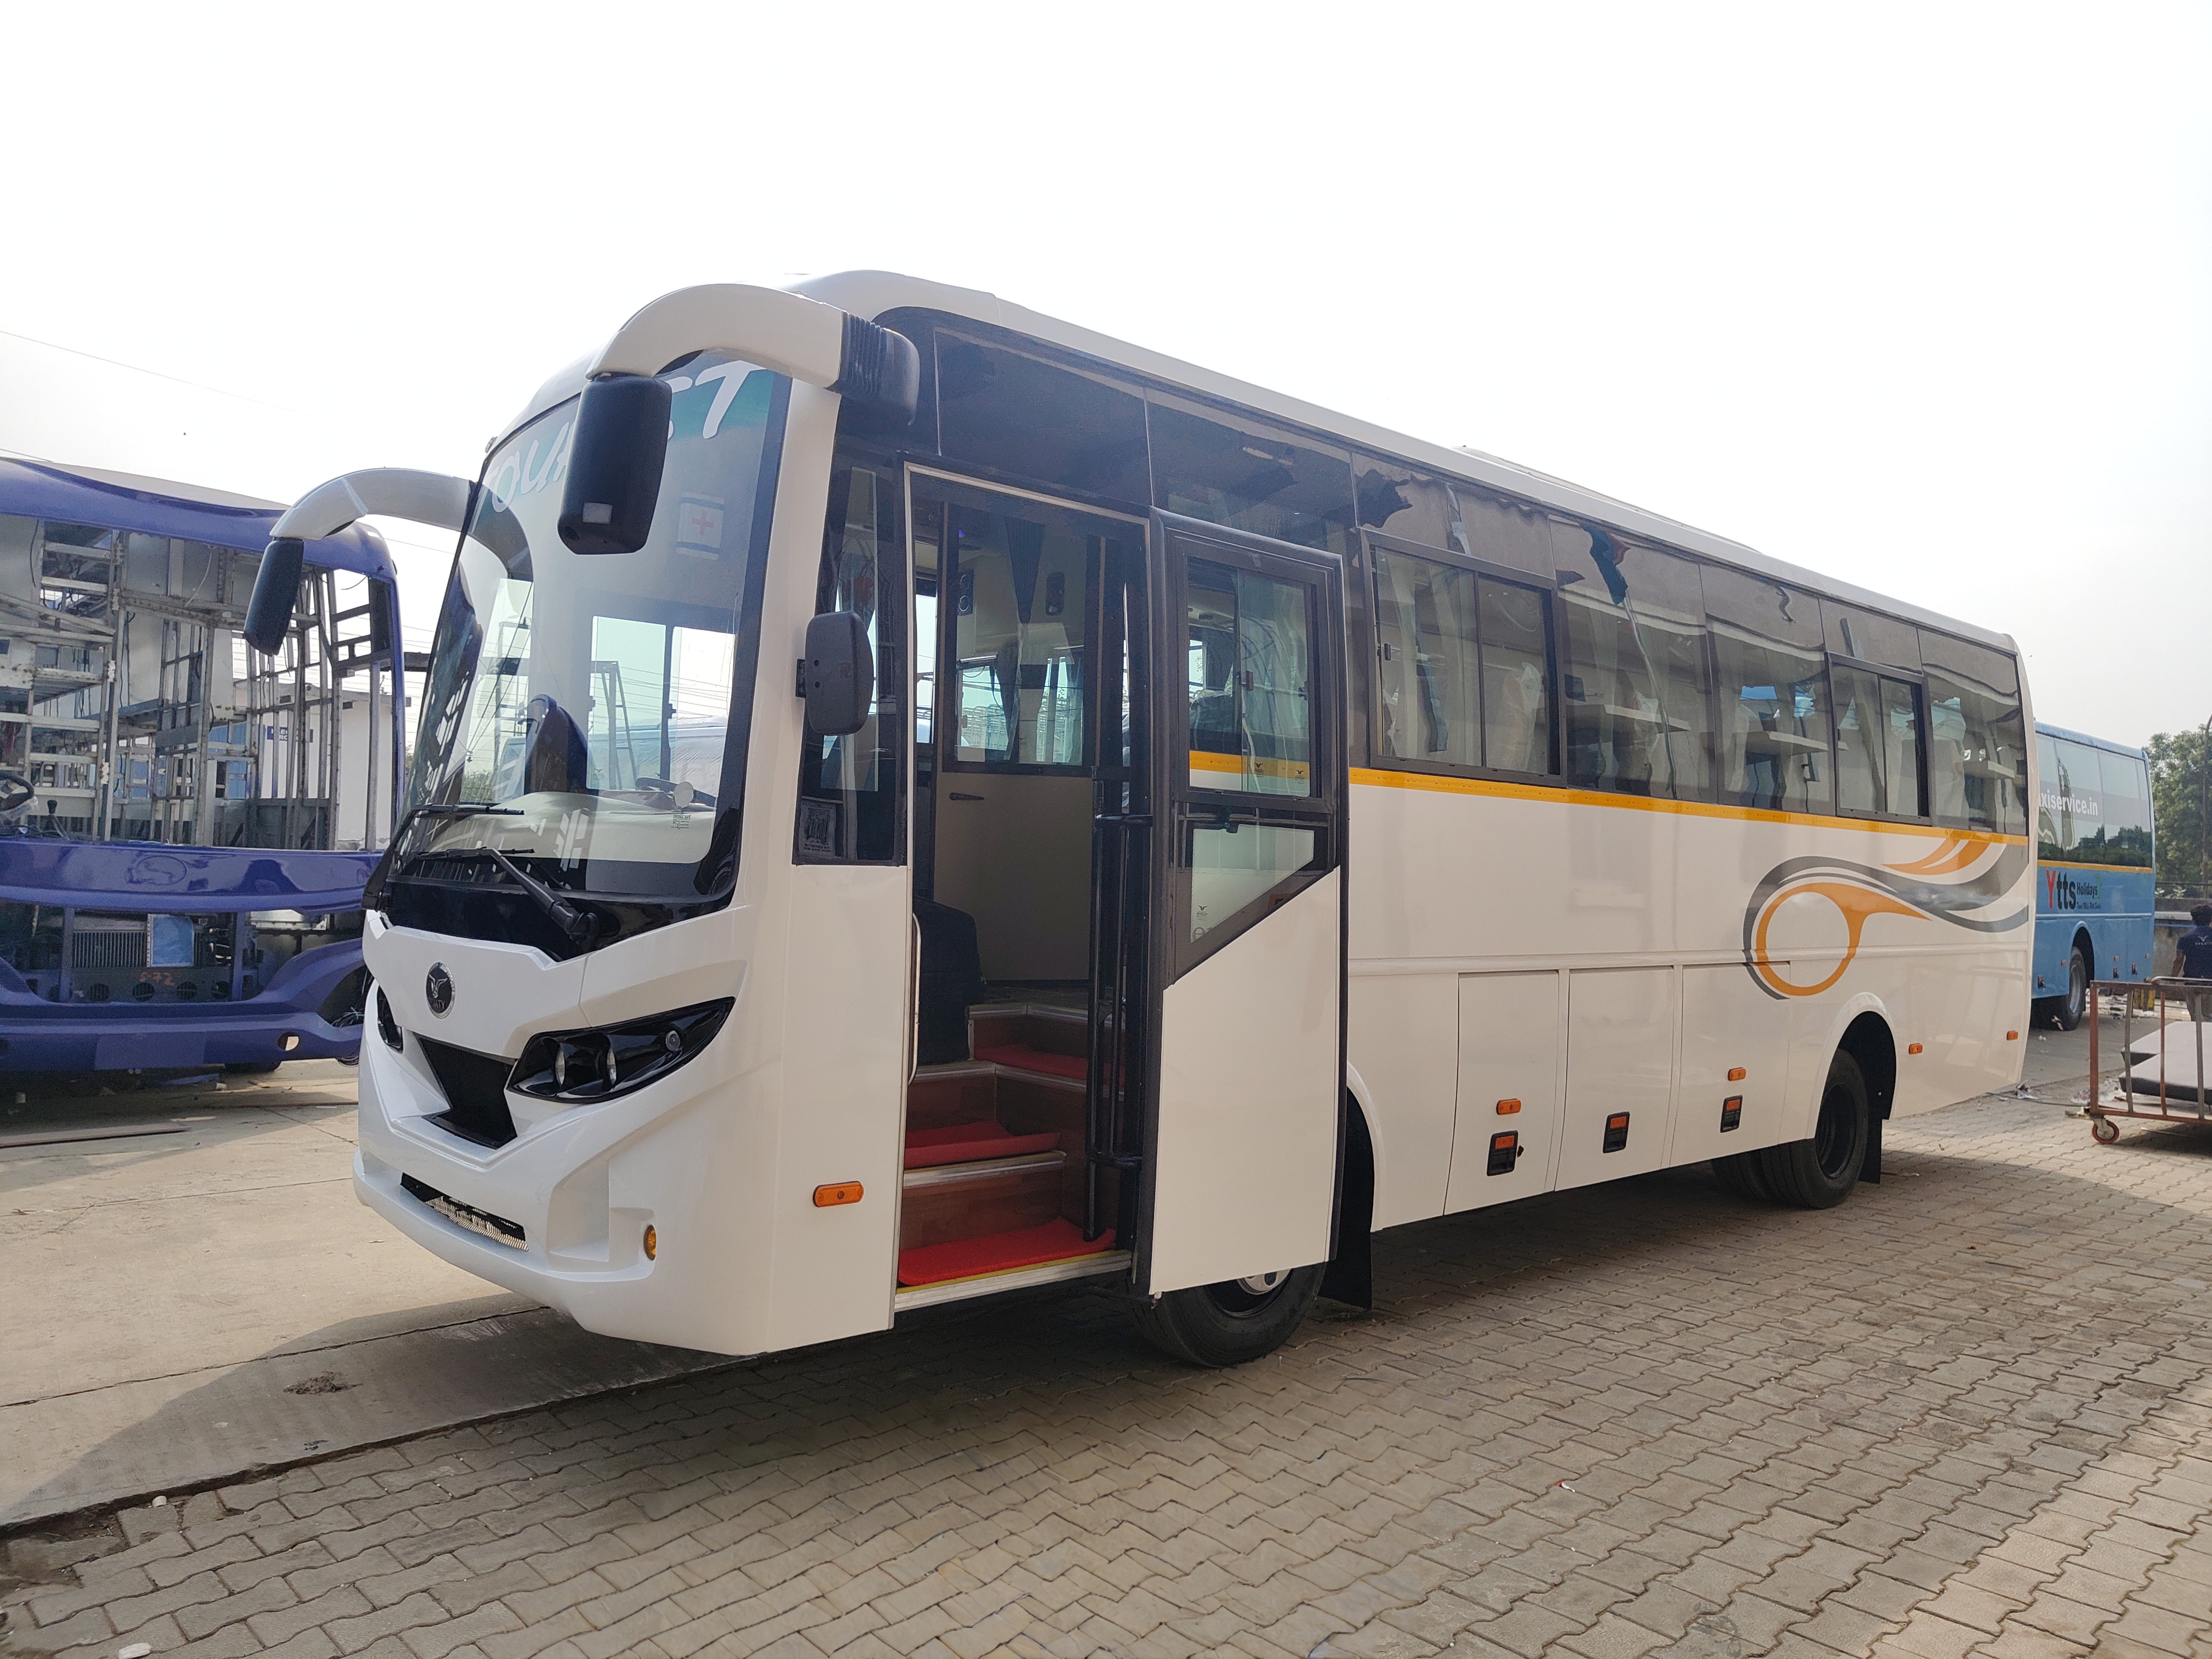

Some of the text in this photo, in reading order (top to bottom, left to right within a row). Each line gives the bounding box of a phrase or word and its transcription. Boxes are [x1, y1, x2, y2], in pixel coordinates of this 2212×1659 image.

[2039, 789, 2098, 816] xiservice.in
[2046, 869, 2098, 910] Ytts Holidays
